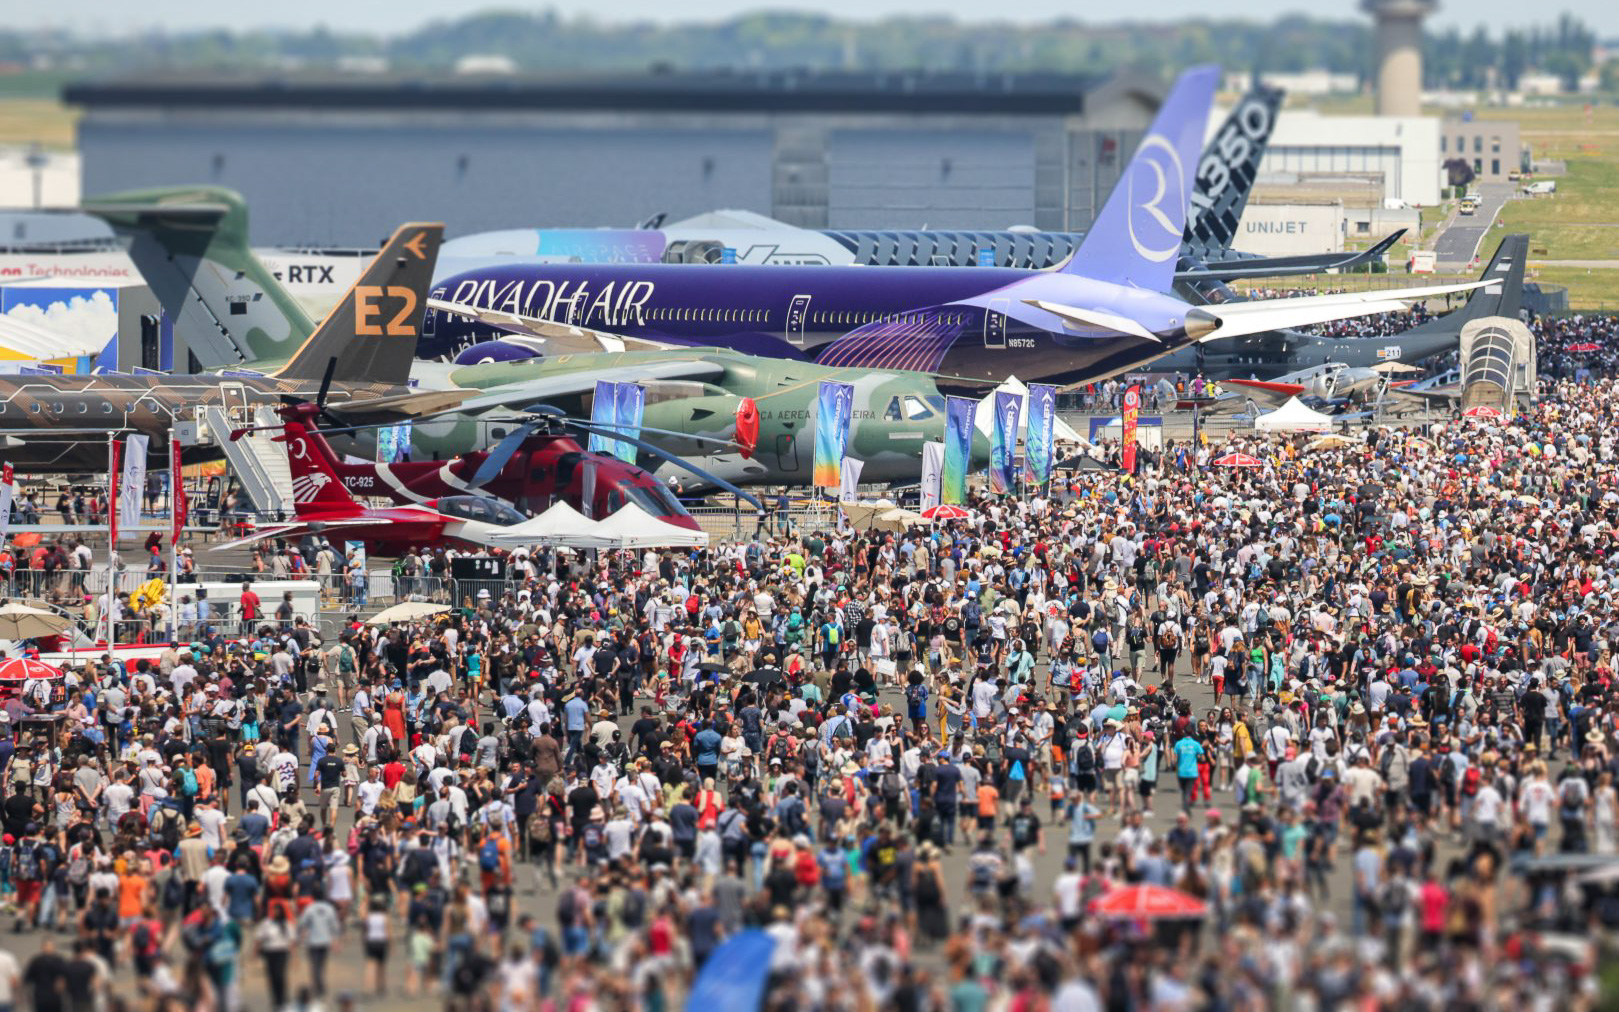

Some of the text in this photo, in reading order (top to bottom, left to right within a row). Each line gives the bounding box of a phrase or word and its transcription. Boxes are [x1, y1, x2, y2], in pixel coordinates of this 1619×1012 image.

[1246, 221, 1308, 234] UNIJET
[288, 265, 335, 284] RTX
[355, 286, 417, 335] E2
[446, 280, 655, 326] RIYADH AIR
[1008, 338, 1036, 348] N8572C
[1386, 349, 1400, 357] 211
[1004, 410, 1015, 467] EMBRAER
[1041, 403, 1050, 458] EMBRAER
[344, 476, 374, 488] TC-925
